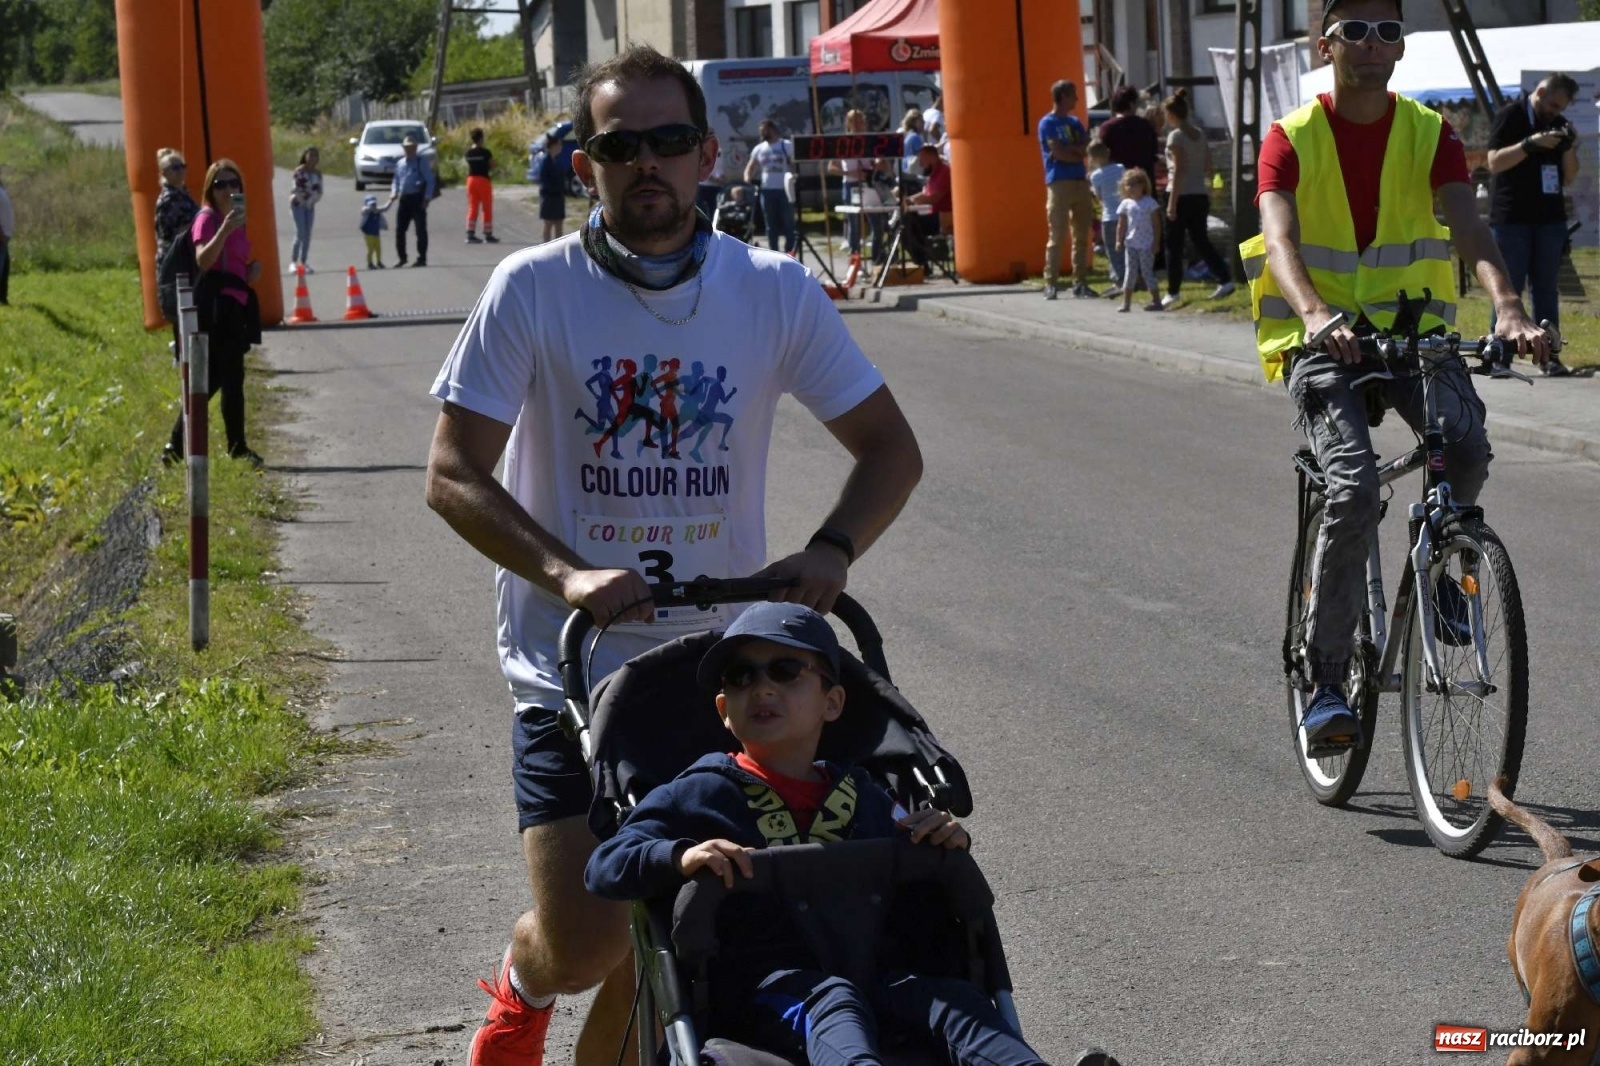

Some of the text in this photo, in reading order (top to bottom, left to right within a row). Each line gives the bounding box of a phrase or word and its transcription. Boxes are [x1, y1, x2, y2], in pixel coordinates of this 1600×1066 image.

[581, 464, 729, 497] COLOUR RUN
[589, 522, 720, 545] COLOUR RUN
[638, 549, 675, 583] 3
